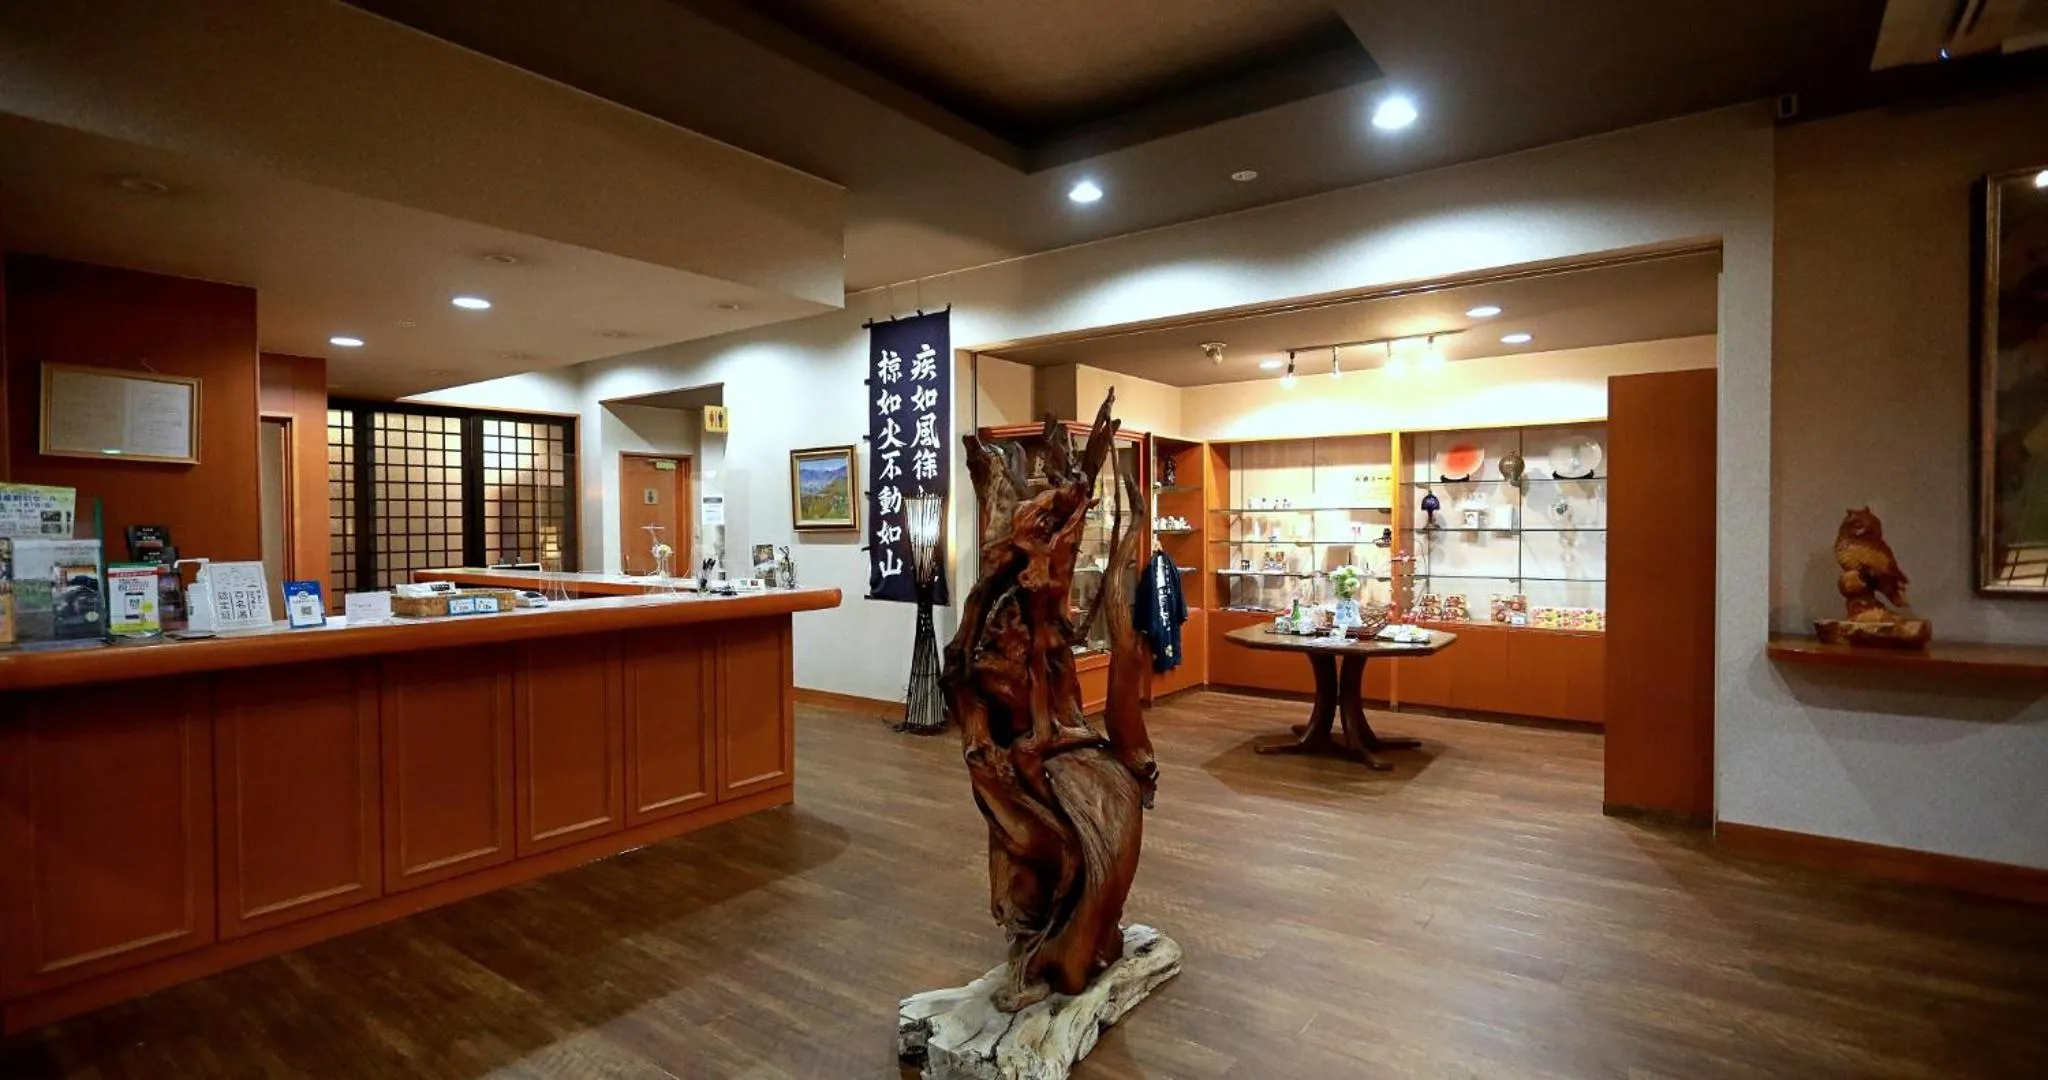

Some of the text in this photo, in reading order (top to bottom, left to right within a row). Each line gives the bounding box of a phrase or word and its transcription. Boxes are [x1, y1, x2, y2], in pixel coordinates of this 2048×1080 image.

[876, 349, 908, 579] 掠如火不動如山
[909, 343, 941, 497] 疾如風徐
